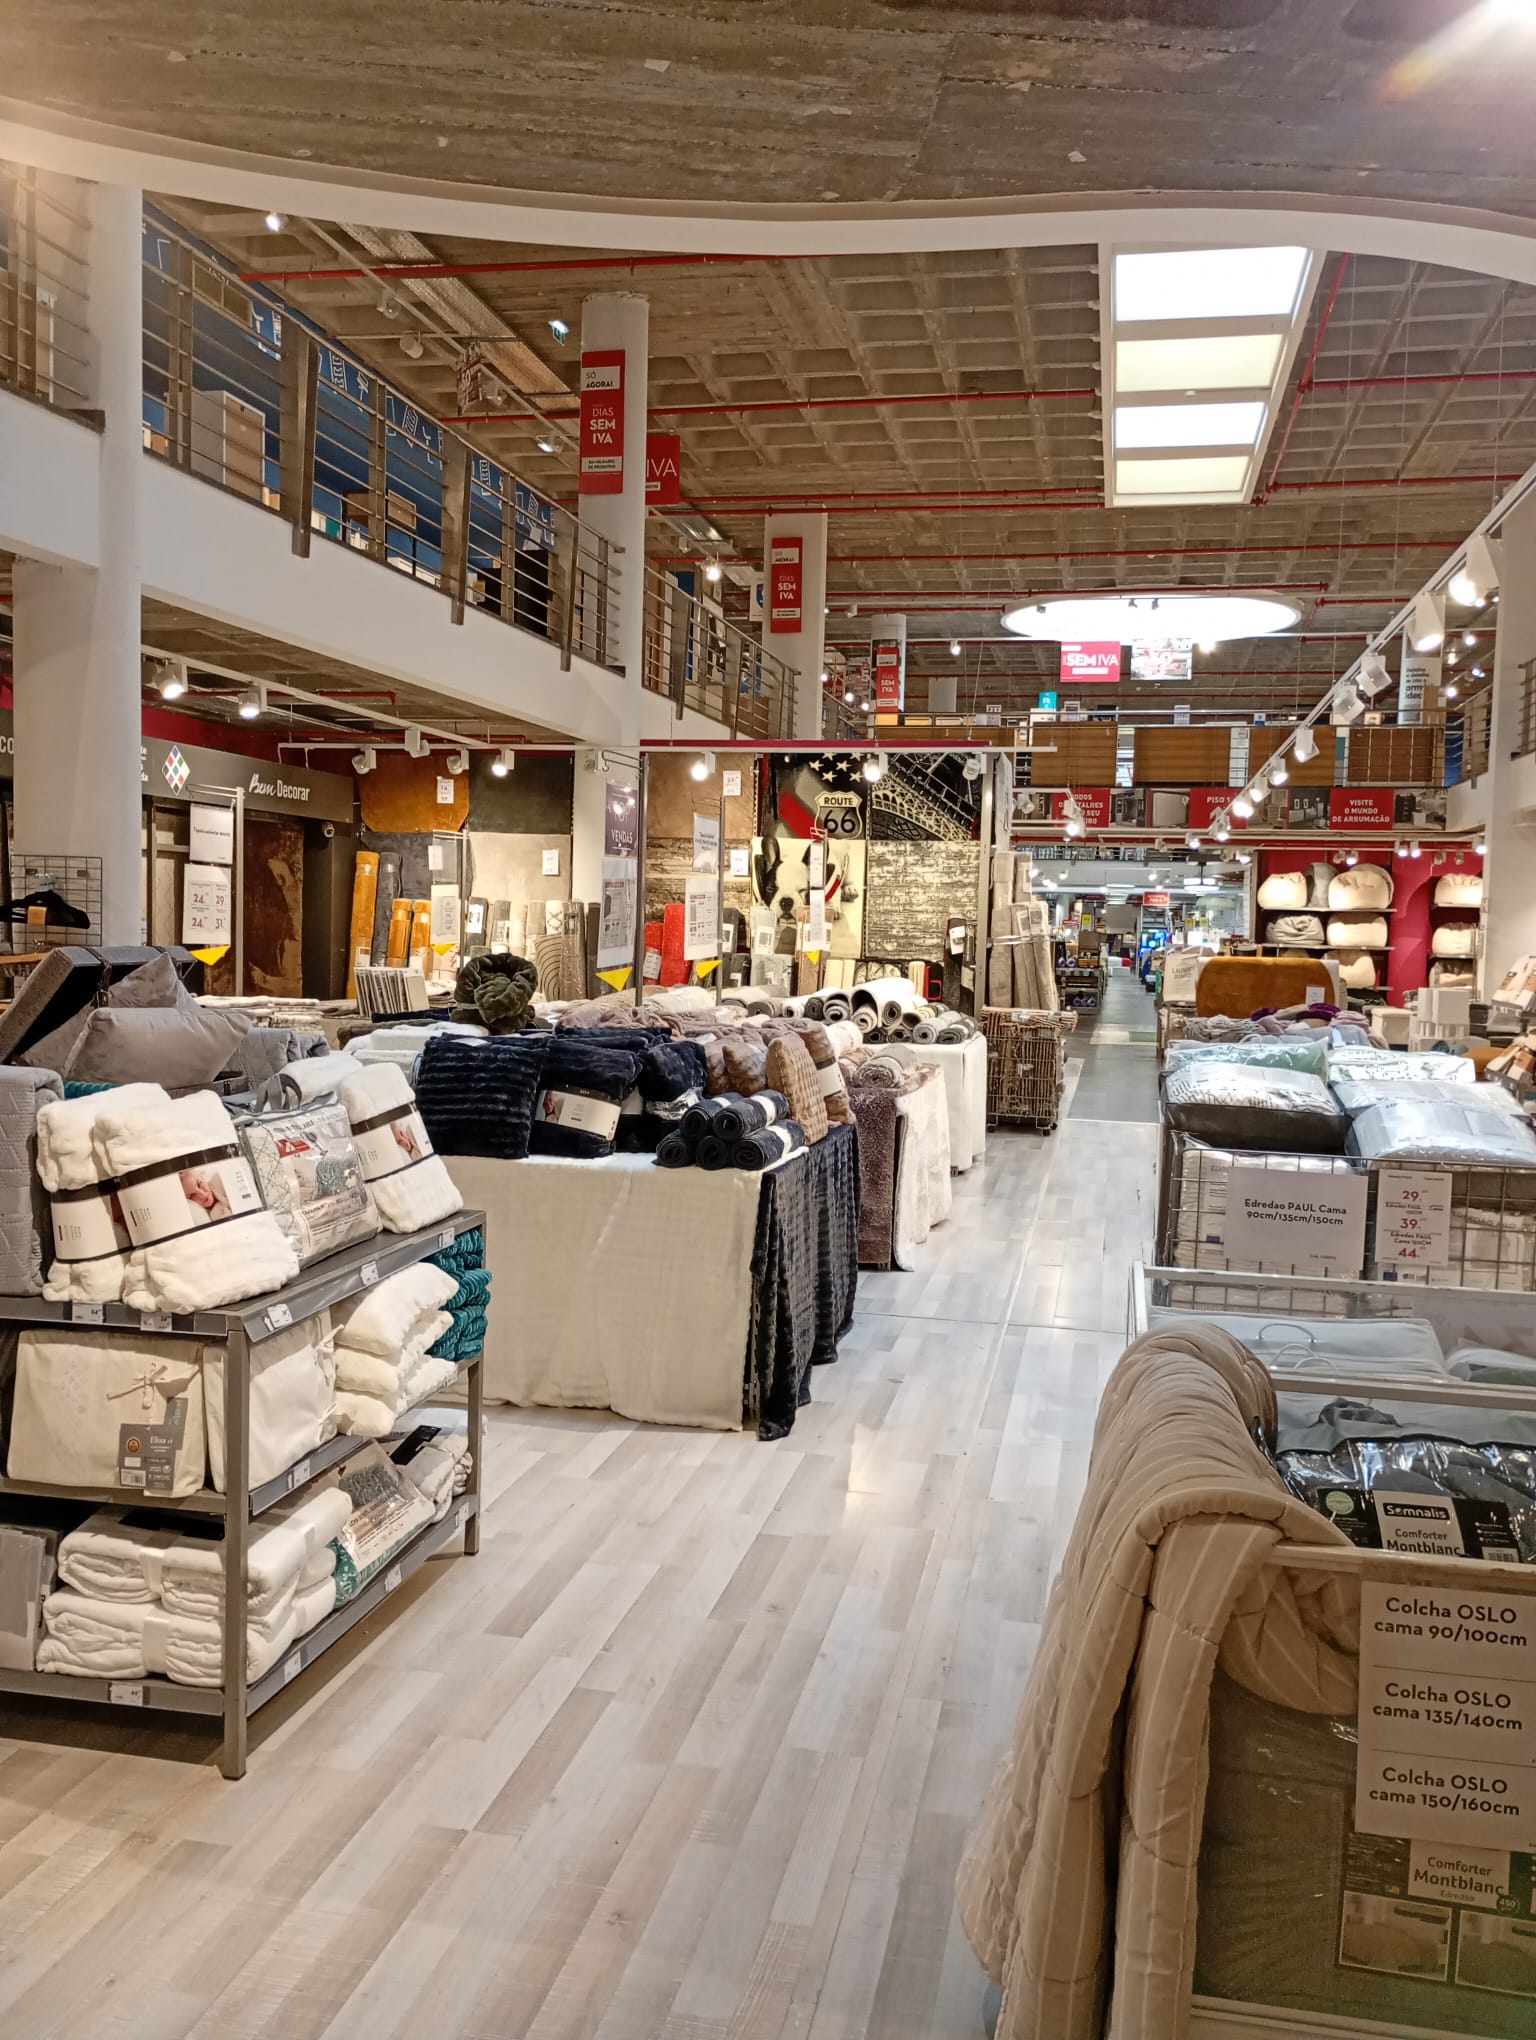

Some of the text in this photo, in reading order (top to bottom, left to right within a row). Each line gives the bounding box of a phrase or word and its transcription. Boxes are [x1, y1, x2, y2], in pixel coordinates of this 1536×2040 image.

[585, 380, 613, 388] AGORA!
[592, 407, 614, 417] DIAS
[590, 418, 616, 430] SEM
[592, 432, 613, 444] IVA
[646, 458, 677, 477] IVA
[778, 582, 796, 591] SEM
[779, 592, 794, 600] IVA
[1066, 653, 1096, 666] SEM
[1098, 654, 1119, 666] IVA
[276, 779, 310, 801] Decorar
[823, 796, 854, 806] ROUTE
[823, 809, 856, 834] 66
[1332, 814, 1390, 823] DE ARRUMAÇÃO
[611, 829, 633, 844] VENDAS
[1401, 1190, 1420, 1202] 29
[1244, 1198, 1347, 1215] Edredao PAUL Cama
[1246, 1210, 1344, 1225] 90cm/135cm/150cm
[1400, 1217, 1418, 1229] 39
[1398, 1247, 1417, 1259] 44
[1394, 1528, 1448, 1541] Comforter
[1386, 1539, 1461, 1556] Montblanc
[1385, 1596, 1517, 1624] Colcha OSLO
[1374, 1621, 1528, 1647] cama 90/100cm
[1385, 1682, 1512, 1709] Colcha OSLO
[1372, 1705, 1523, 1731] cama 135/140cm
[1382, 1766, 1508, 1794] Colcha OSLO
[1369, 1789, 1520, 1816] cama 150/160cm
[1427, 1856, 1493, 1876] Comforter
[1413, 1868, 1505, 1897] Montblanc
